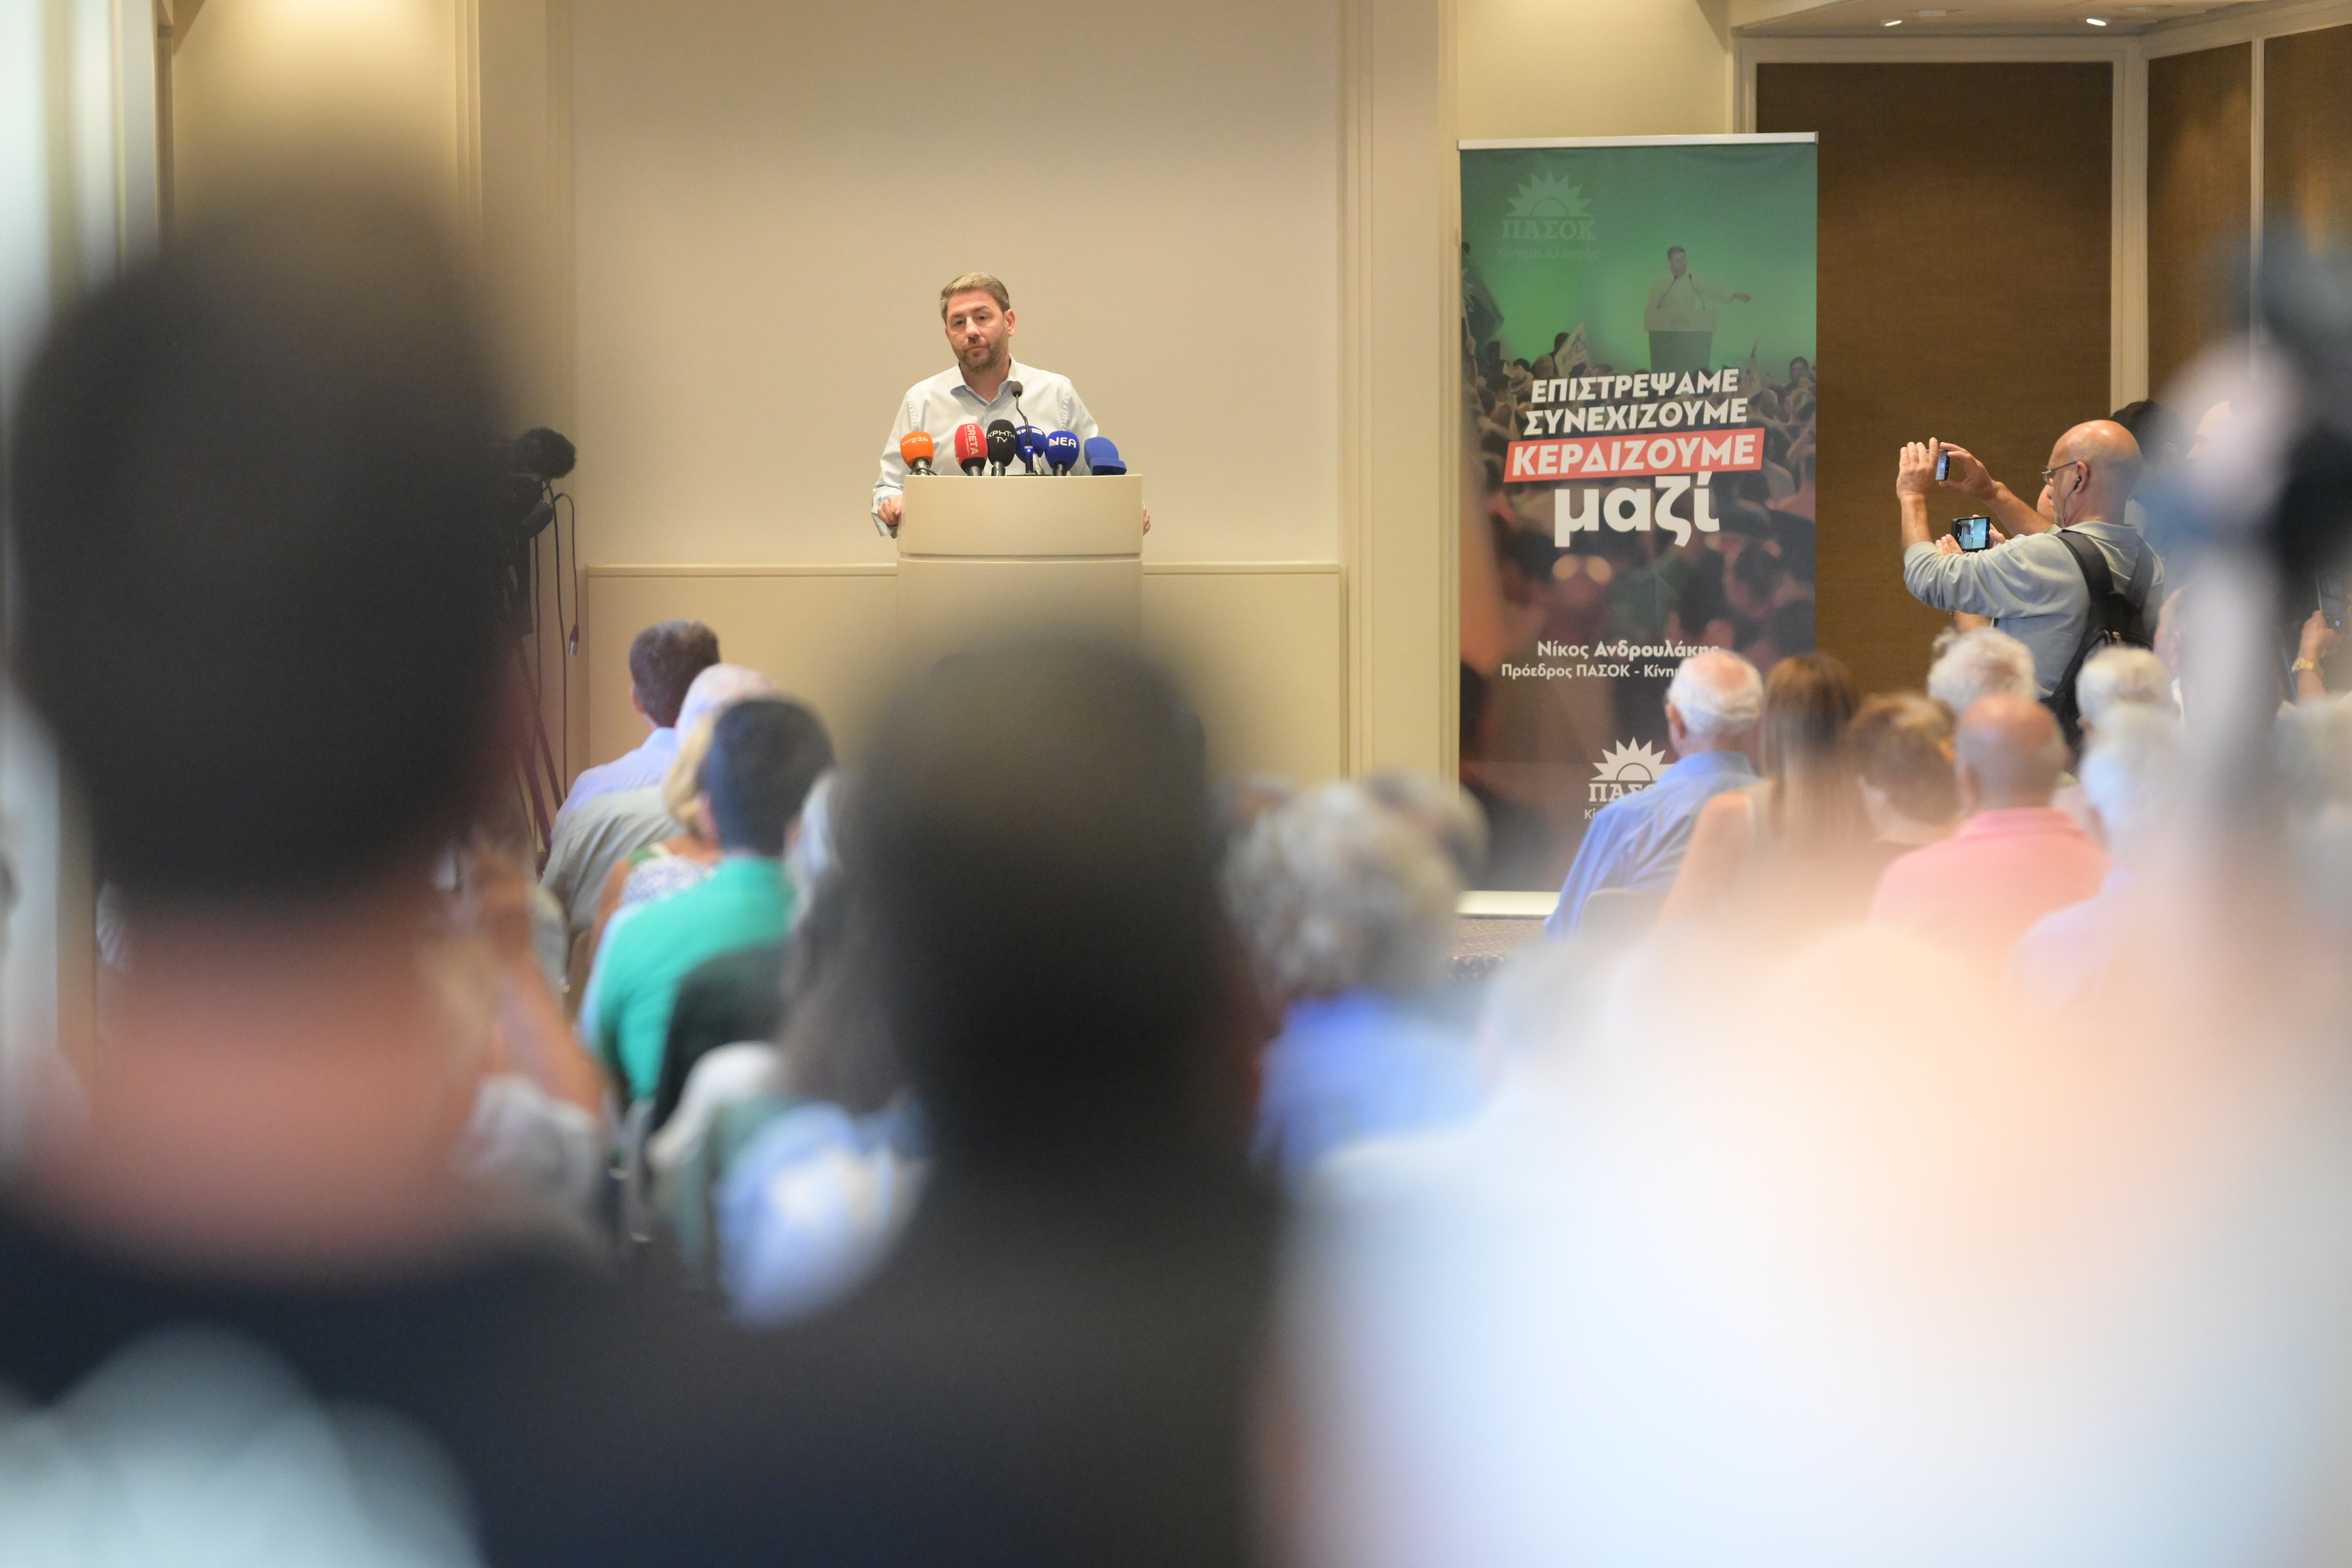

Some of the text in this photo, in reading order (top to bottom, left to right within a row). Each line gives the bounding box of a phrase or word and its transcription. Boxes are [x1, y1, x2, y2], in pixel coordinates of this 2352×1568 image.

[1501, 219, 1596, 240] ΠΑΣΟΚ
[1531, 368, 1739, 404] ΕΠΙΣΤΡΕΨΑΜΕ
[1523, 397, 1748, 436] ΣΥΝΕΧΙΖΟΥΜΕ
[967, 424, 979, 456] CRETA
[1512, 434, 1756, 476] ΚΕΡΔΙΖΟΥΜΕ
[1554, 470, 1720, 547] μαζί
[1538, 640, 1589, 660] Νίκος
[1502, 663, 1572, 679] Πρόεδρος
[1576, 664, 1630, 677] ΠΑΣΟΚ
[1643, 663, 1678, 677] Κίνη
